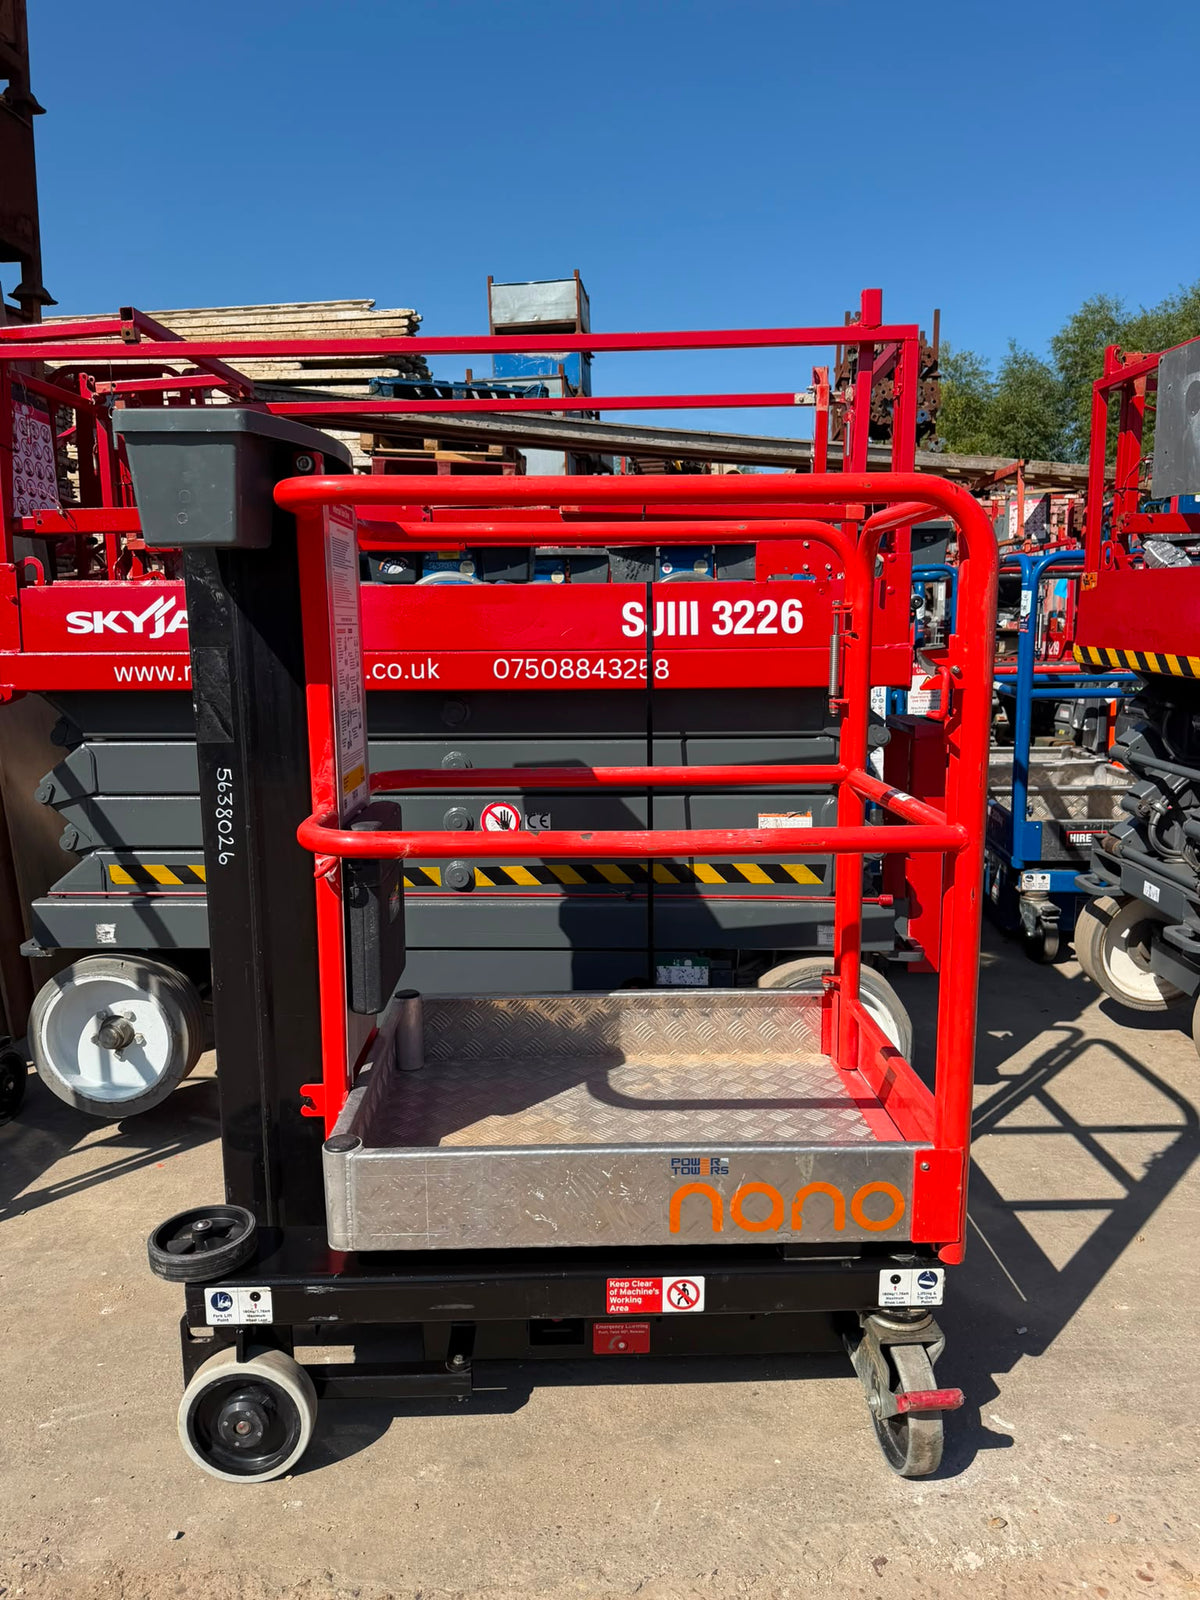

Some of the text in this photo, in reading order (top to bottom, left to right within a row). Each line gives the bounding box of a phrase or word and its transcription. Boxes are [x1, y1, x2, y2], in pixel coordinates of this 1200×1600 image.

[621, 598, 804, 638] SJIII 3226
[492, 657, 670, 680] 07508843258
[215, 767, 235, 865] 5638026
[1069, 833, 1092, 843] HIRE
[669, 1181, 906, 1234] nano
[609, 1280, 653, 1289] Keep Clear
[609, 1287, 660, 1296] of Machine's
[609, 1296, 642, 1305] Working
[609, 1304, 629, 1312] Area
